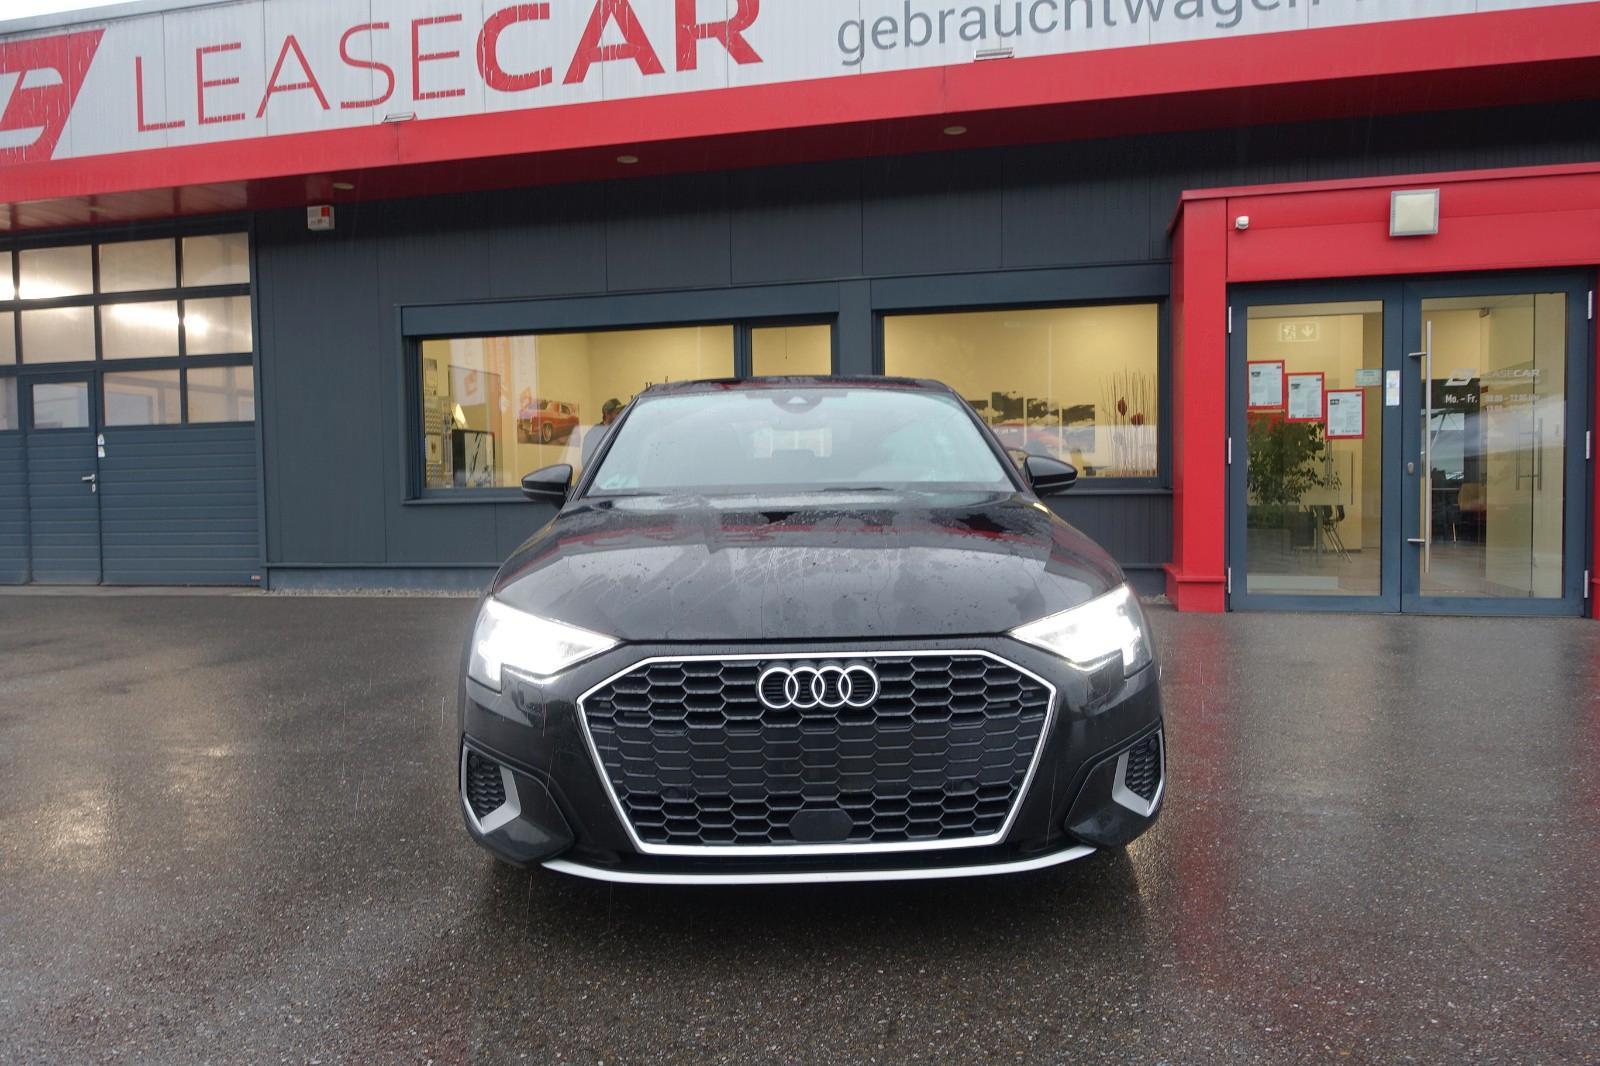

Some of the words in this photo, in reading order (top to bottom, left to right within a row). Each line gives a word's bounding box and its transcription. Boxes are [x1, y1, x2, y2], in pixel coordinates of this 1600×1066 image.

[135, 0, 763, 132] LEASECAR
[838, 0, 1320, 67] gebrauchtwag
[1445, 394, 1459, 403] Mo.
[1467, 393, 1478, 403] Fr.
